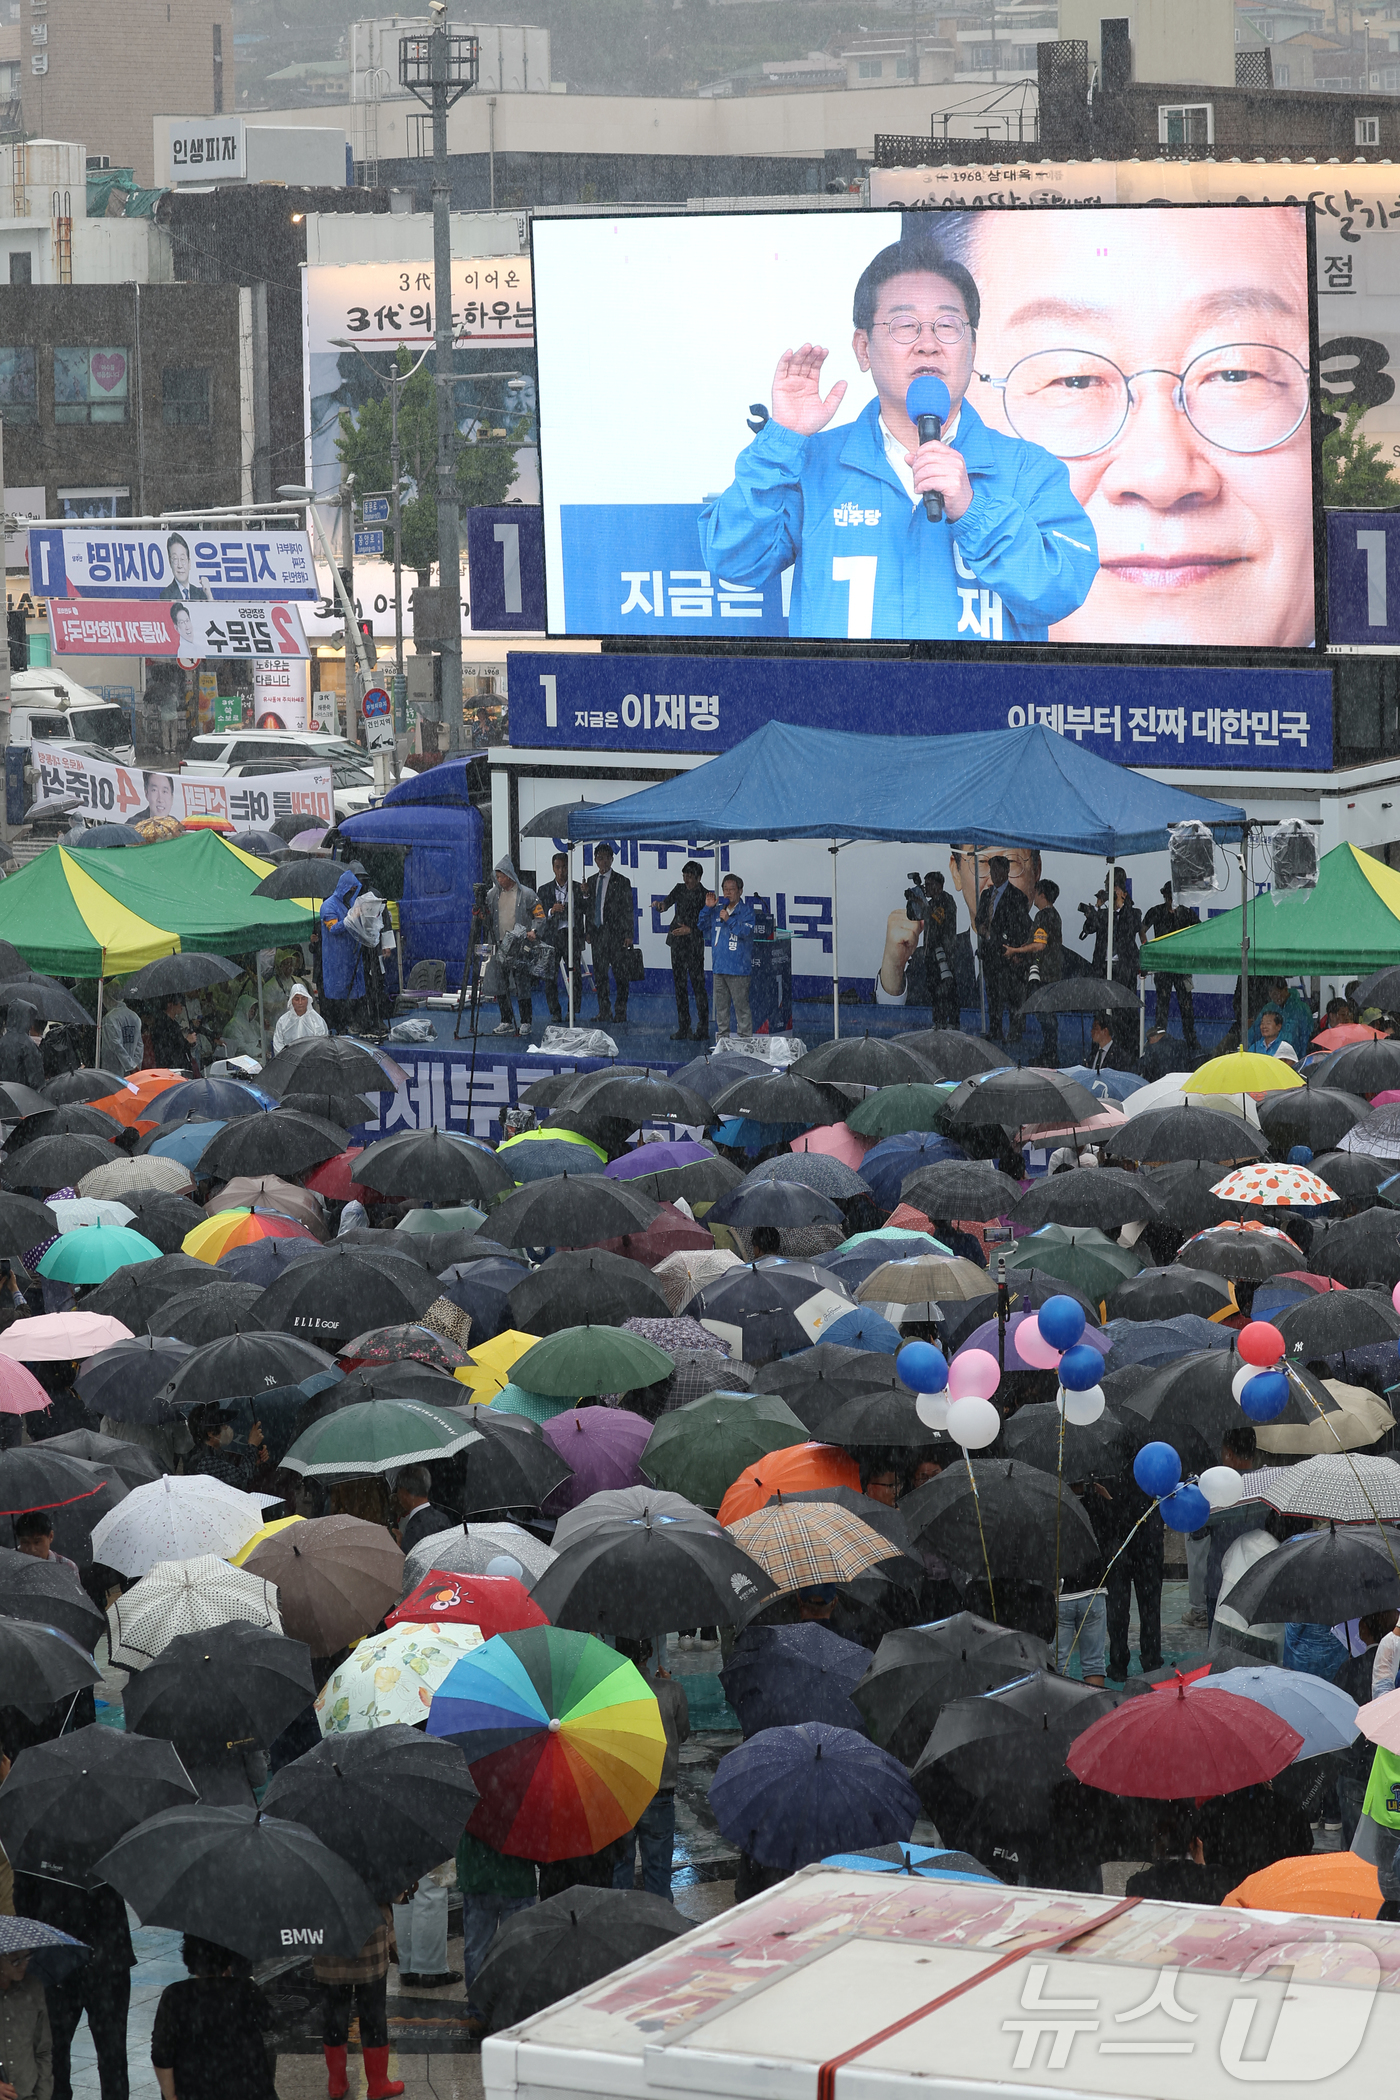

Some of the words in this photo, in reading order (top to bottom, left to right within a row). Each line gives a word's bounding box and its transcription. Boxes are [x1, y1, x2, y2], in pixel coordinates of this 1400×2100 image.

[173, 136, 236, 165] 인생피자
[953, 170, 982, 183] 1968
[465, 270, 520, 290] 이어온
[833, 508, 882, 526] 민주당
[358, 534, 375, 546] 중앙로
[493, 523, 522, 613] 1
[1356, 530, 1388, 627] 1
[620, 570, 764, 618] 지금은
[832, 555, 878, 639] 1
[256, 660, 290, 671] 노하우는
[366, 701, 387, 711] 주정차금지
[540, 674, 557, 727] 1
[217, 714, 240, 722] 소보로
[574, 710, 619, 728] 지금은
[621, 693, 720, 731] 이재명
[367, 718, 391, 729] 견인지역
[1008, 703, 1121, 742] 이제부터
[1128, 705, 1188, 743] 진짜
[1191, 706, 1311, 748] 대한민국
[293, 1316, 321, 1328] ELLE
[321, 1320, 340, 1329] GOLF
[992, 1846, 1019, 1863] FILA
[280, 1928, 324, 1946] BMW
